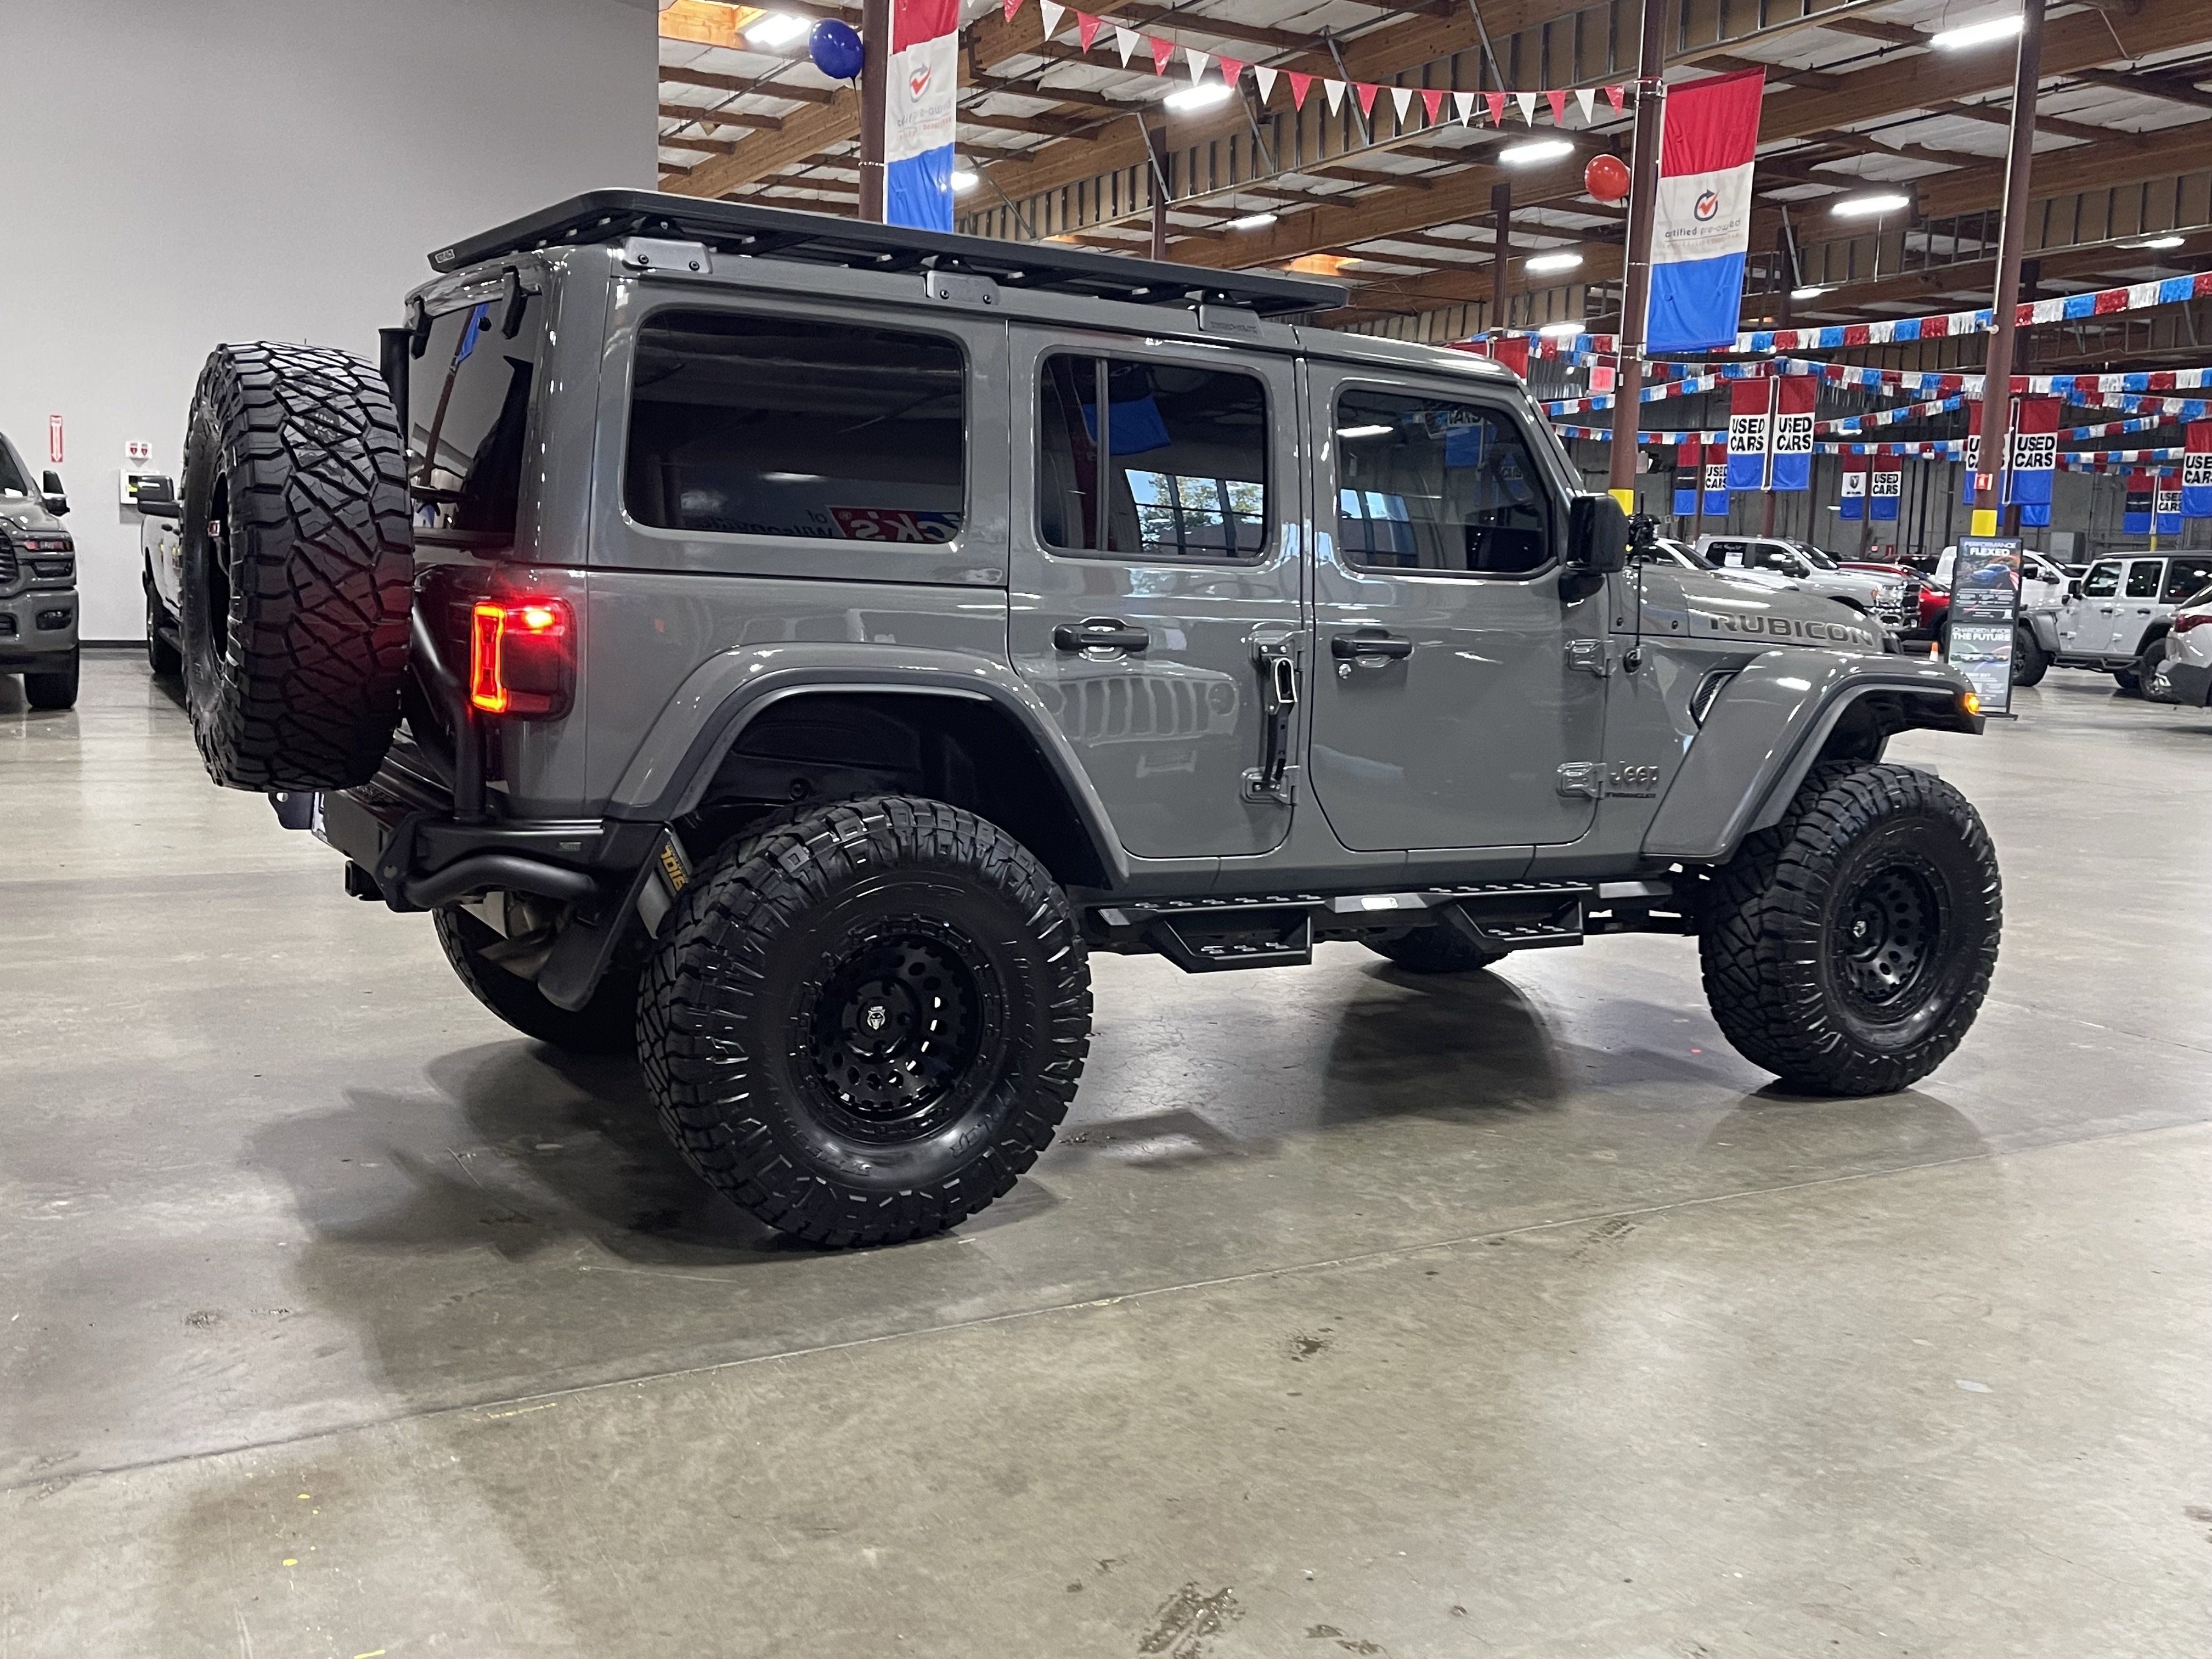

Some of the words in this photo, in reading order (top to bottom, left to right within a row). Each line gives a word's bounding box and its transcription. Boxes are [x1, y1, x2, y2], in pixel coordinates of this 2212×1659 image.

[1732, 418, 1765, 434] USED
[1779, 416, 1813, 433] USED
[1730, 435, 1764, 451] CARS
[1777, 434, 1812, 450] CARS
[2017, 436, 2056, 452] USED
[2015, 452, 2053, 467] CARS
[2185, 455, 2212, 469] USE
[1875, 473, 1899, 483] USED
[2184, 470, 2212, 484] CAR
[1872, 484, 1898, 494] CARS
[2160, 492, 2182, 501] USE
[1970, 547, 2011, 556] FLEXED
[1708, 611, 1875, 647] RUBICON
[1953, 632, 1972, 641] THE
[1973, 633, 2011, 642] FUTURE
